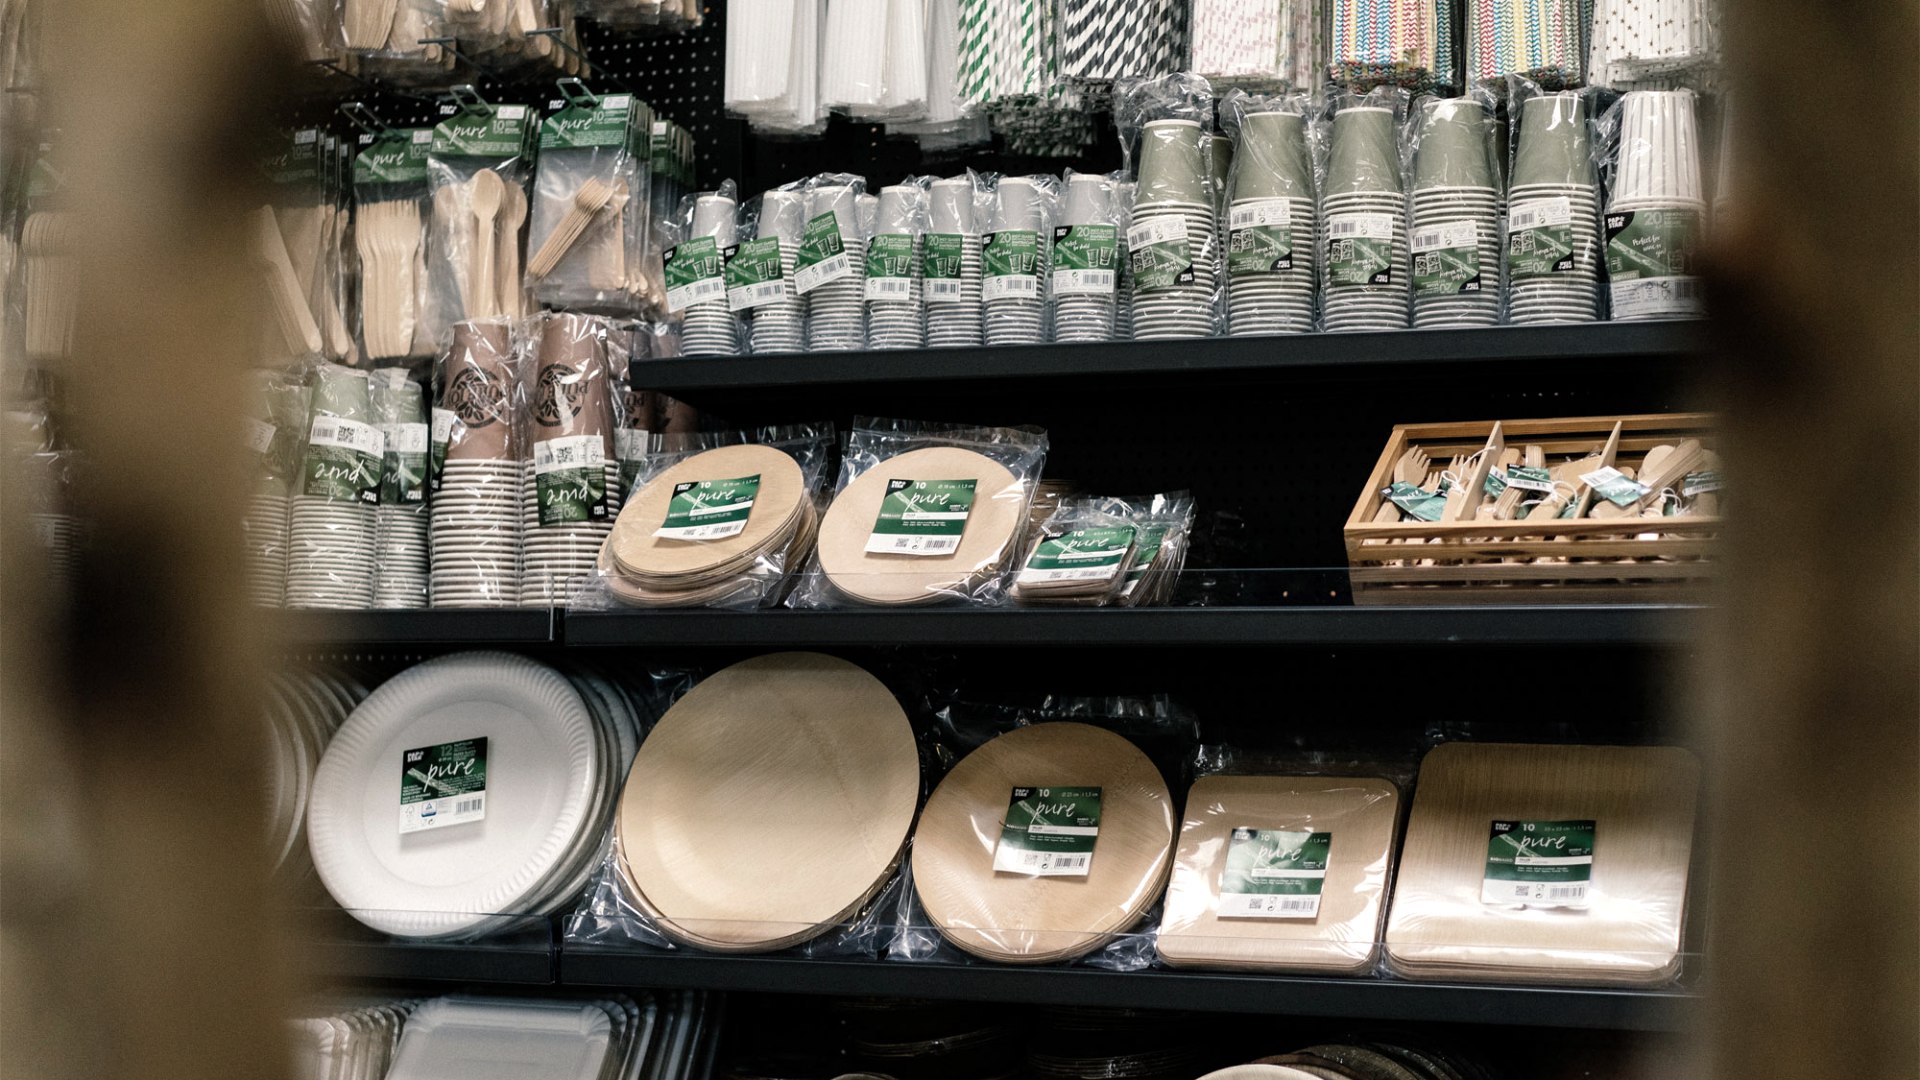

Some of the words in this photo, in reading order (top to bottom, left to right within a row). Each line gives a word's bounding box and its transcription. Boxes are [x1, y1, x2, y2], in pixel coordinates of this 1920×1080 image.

[593, 111, 604, 122] 10
[493, 120, 505, 132] 10
[557, 117, 594, 138] pure
[449, 124, 487, 145] pure
[409, 145, 422, 158] 10
[371, 151, 404, 174] pure
[1644, 212, 1662, 226] 20
[998, 232, 1010, 244] 20
[1076, 227, 1090, 238] 20
[929, 236, 939, 246] 20
[1632, 236, 1652, 246] Perfect
[681, 243, 692, 254] 20
[744, 243, 754, 254] 20
[1253, 259, 1265, 270] 20
[1533, 262, 1546, 272] 20
[1156, 275, 1168, 286] 20
[1350, 272, 1363, 282] 20
[314, 459, 364, 484] pure
[329, 485, 342, 497] 20
[546, 474, 588, 506] pure
[691, 488, 736, 510] pure
[904, 492, 951, 513] pure
[564, 506, 578, 517] 20
[1062, 537, 1109, 554] pure
[440, 746, 452, 757] 12
[423, 758, 476, 792] pure
[1038, 789, 1050, 797] 10
[1030, 802, 1076, 824] pure
[1517, 835, 1566, 856] pure
[1252, 845, 1302, 866] pure
